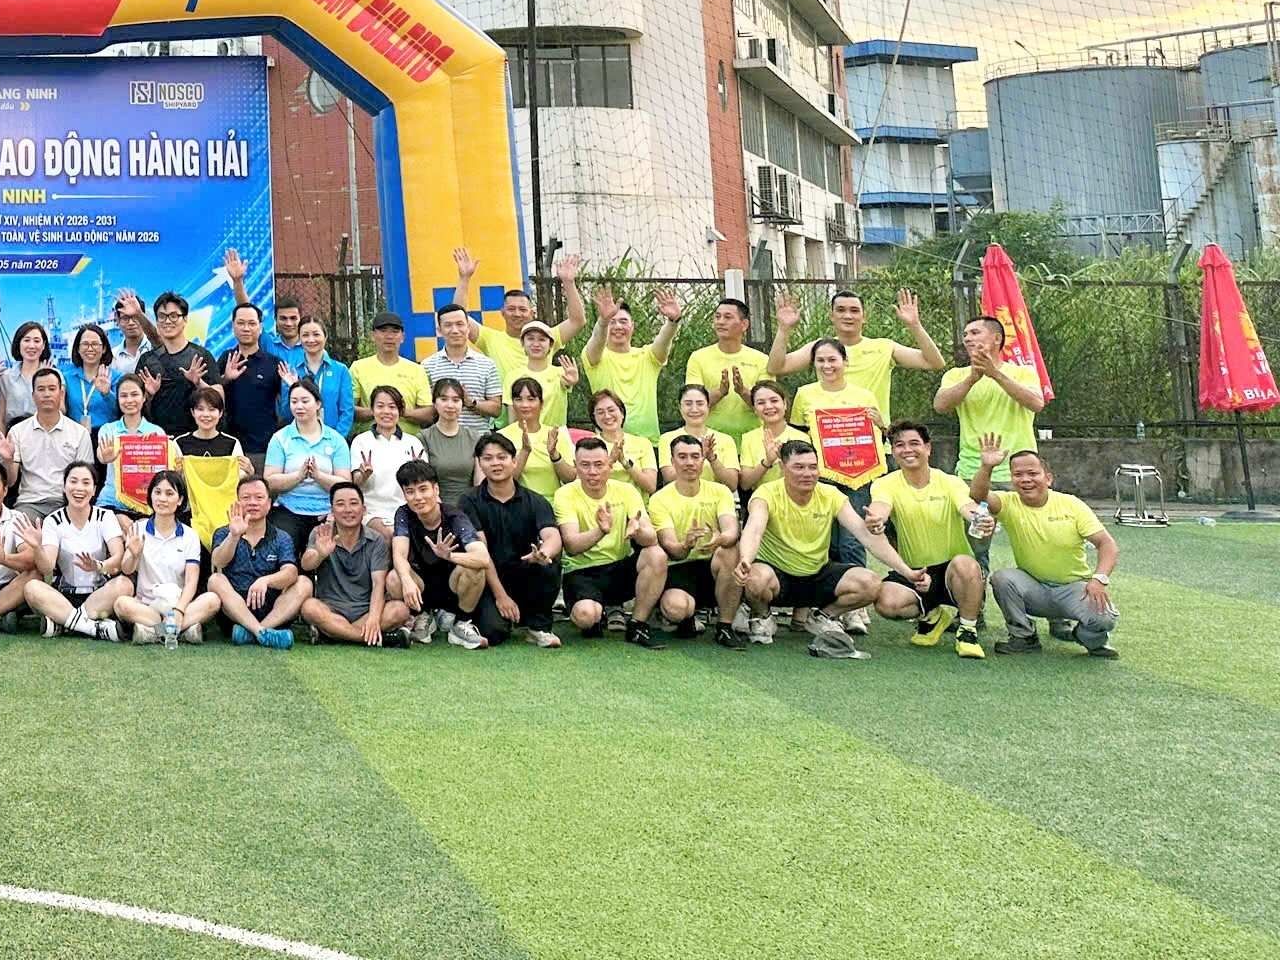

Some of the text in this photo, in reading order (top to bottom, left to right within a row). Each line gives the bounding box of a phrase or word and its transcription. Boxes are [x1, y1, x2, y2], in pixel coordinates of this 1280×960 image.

[26, 88, 57, 100] NINH
[158, 84, 203, 100] NOSCO
[44, 130, 121, 185] ĐỘNG
[128, 131, 200, 177] HÀNG
[207, 129, 249, 177] HẢI
[2, 189, 46, 204] NINH
[3, 215, 20, 228] XIV,
[23, 212, 52, 228] NHIỆM
[67, 216, 88, 226] 2026
[96, 216, 117, 226] 2031
[1, 230, 26, 244] TOÀN,
[28, 228, 40, 244] VỆ
[42, 232, 63, 242] SINH
[65, 232, 82, 242] LAO
[116, 230, 136, 242] NĂM
[137, 232, 160, 242] 2026
[11, 260, 32, 269] năm
[34, 260, 58, 269] 2026
